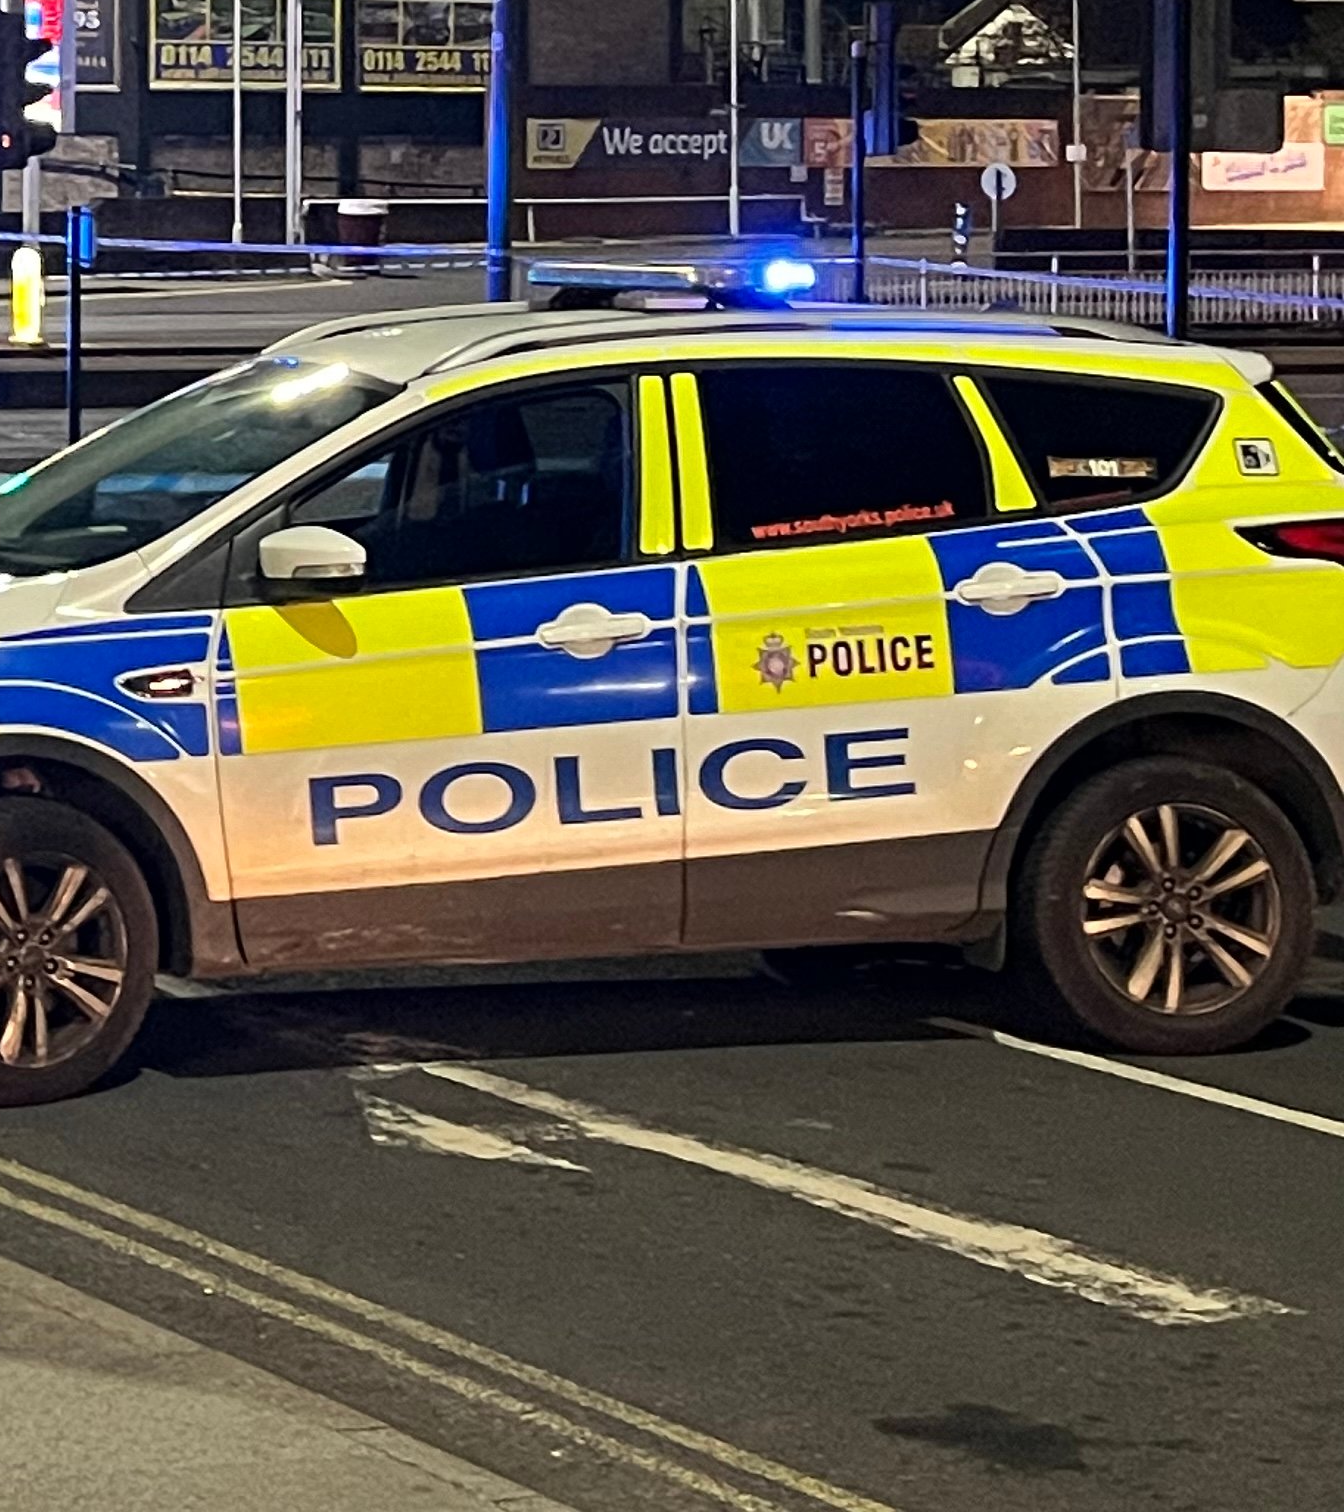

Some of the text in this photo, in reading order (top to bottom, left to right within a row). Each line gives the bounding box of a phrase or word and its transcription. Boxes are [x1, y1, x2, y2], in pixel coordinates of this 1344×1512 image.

[160, 44, 212, 66] 0114
[363, 49, 490, 72] 0114 2544 11
[602, 126, 643, 155] We
[648, 128, 728, 160] accept
[1088, 459, 1119, 477] 101
[750, 500, 956, 539] www.southyorks.police.uk
[806, 634, 935, 678] POLICE
[307, 727, 917, 846] POLICE
